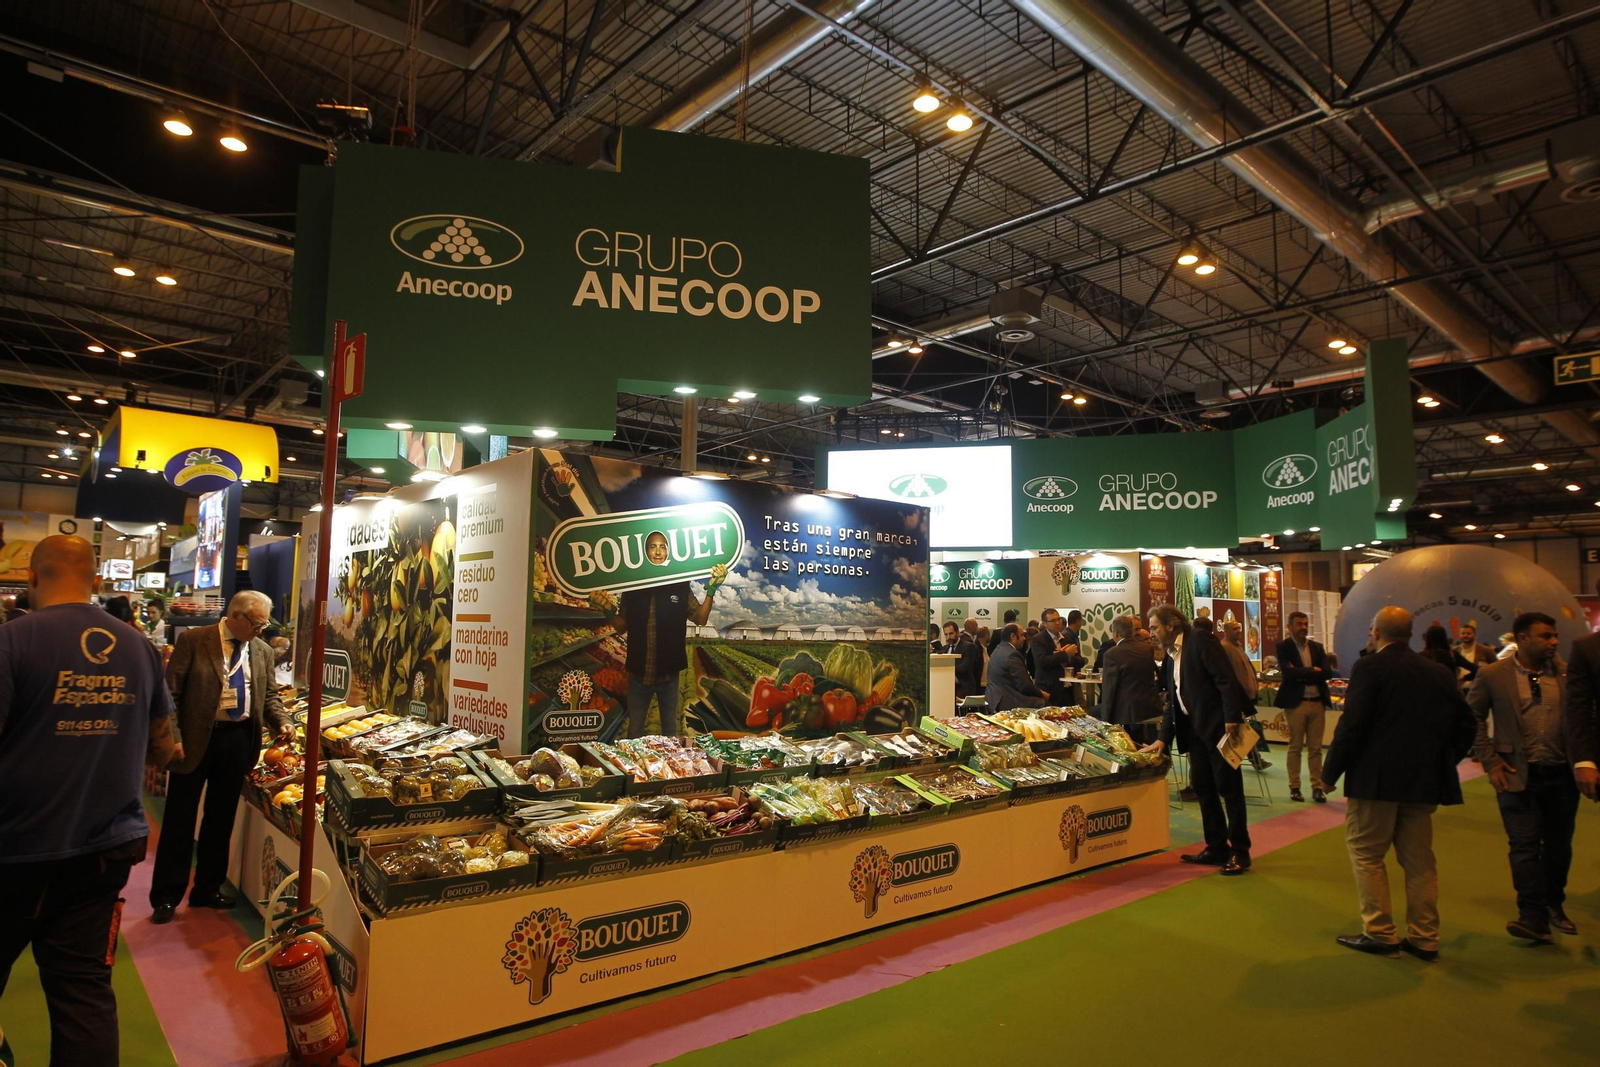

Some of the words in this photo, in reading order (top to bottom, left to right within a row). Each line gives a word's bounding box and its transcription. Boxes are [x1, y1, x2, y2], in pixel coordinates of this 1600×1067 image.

[575, 228, 742, 278] GRUPO
[396, 271, 513, 306] Anecoop
[571, 270, 822, 325] ANECOOP
[1098, 471, 1178, 492] GRUPO
[462, 493, 497, 519] calidad
[1026, 501, 1074, 515] Anecoop
[1098, 491, 1218, 512] ANECOOP
[1266, 488, 1315, 509] Anecoop
[460, 516, 504, 543] premium
[764, 515, 800, 534] Tras
[807, 524, 832, 537] una
[839, 528, 870, 543] gran
[567, 522, 728, 578] BOUQUET
[764, 539, 808, 555] están
[816, 544, 872, 561] siempre
[459, 564, 495, 583] residuo
[764, 557, 790, 571] las
[797, 562, 870, 578] personas.
[958, 568, 995, 579] GRUPO
[1081, 568, 1126, 583] BOUQUET
[457, 587, 479, 603] cero
[958, 579, 1013, 590] ANECOOP
[1448, 596, 1457, 606] 5
[1462, 599, 1477, 608] al
[1479, 604, 1502, 622] día
[456, 626, 508, 647] mandarina
[455, 648, 473, 665] con
[475, 647, 497, 672] hoja
[56, 670, 126, 690] Fragma
[52, 687, 136, 708] Espacios
[453, 693, 508, 720] variedades
[75, 720, 92, 730] 45
[549, 715, 599, 728] BOUQUET
[548, 735, 581, 743] Cultivamos
[665, 785, 692, 794] BOUQUET
[409, 810, 442, 820] BOUQUET
[1087, 812, 1129, 834] BOUQUET
[712, 843, 741, 854] BOUQUET
[1087, 842, 1112, 854] Cultivamos
[1113, 839, 1128, 848] futuro
[593, 861, 626, 873] BOUQUET
[893, 850, 956, 881] BOUQUET
[446, 884, 485, 898] BOUQUET
[893, 889, 932, 905] Cultivamos
[933, 883, 953, 896] futuro
[579, 910, 682, 953] BOUQUET
[288, 956, 318, 978] ZENITH
[579, 962, 643, 984] Cultivamos
[644, 953, 677, 969] futuro
